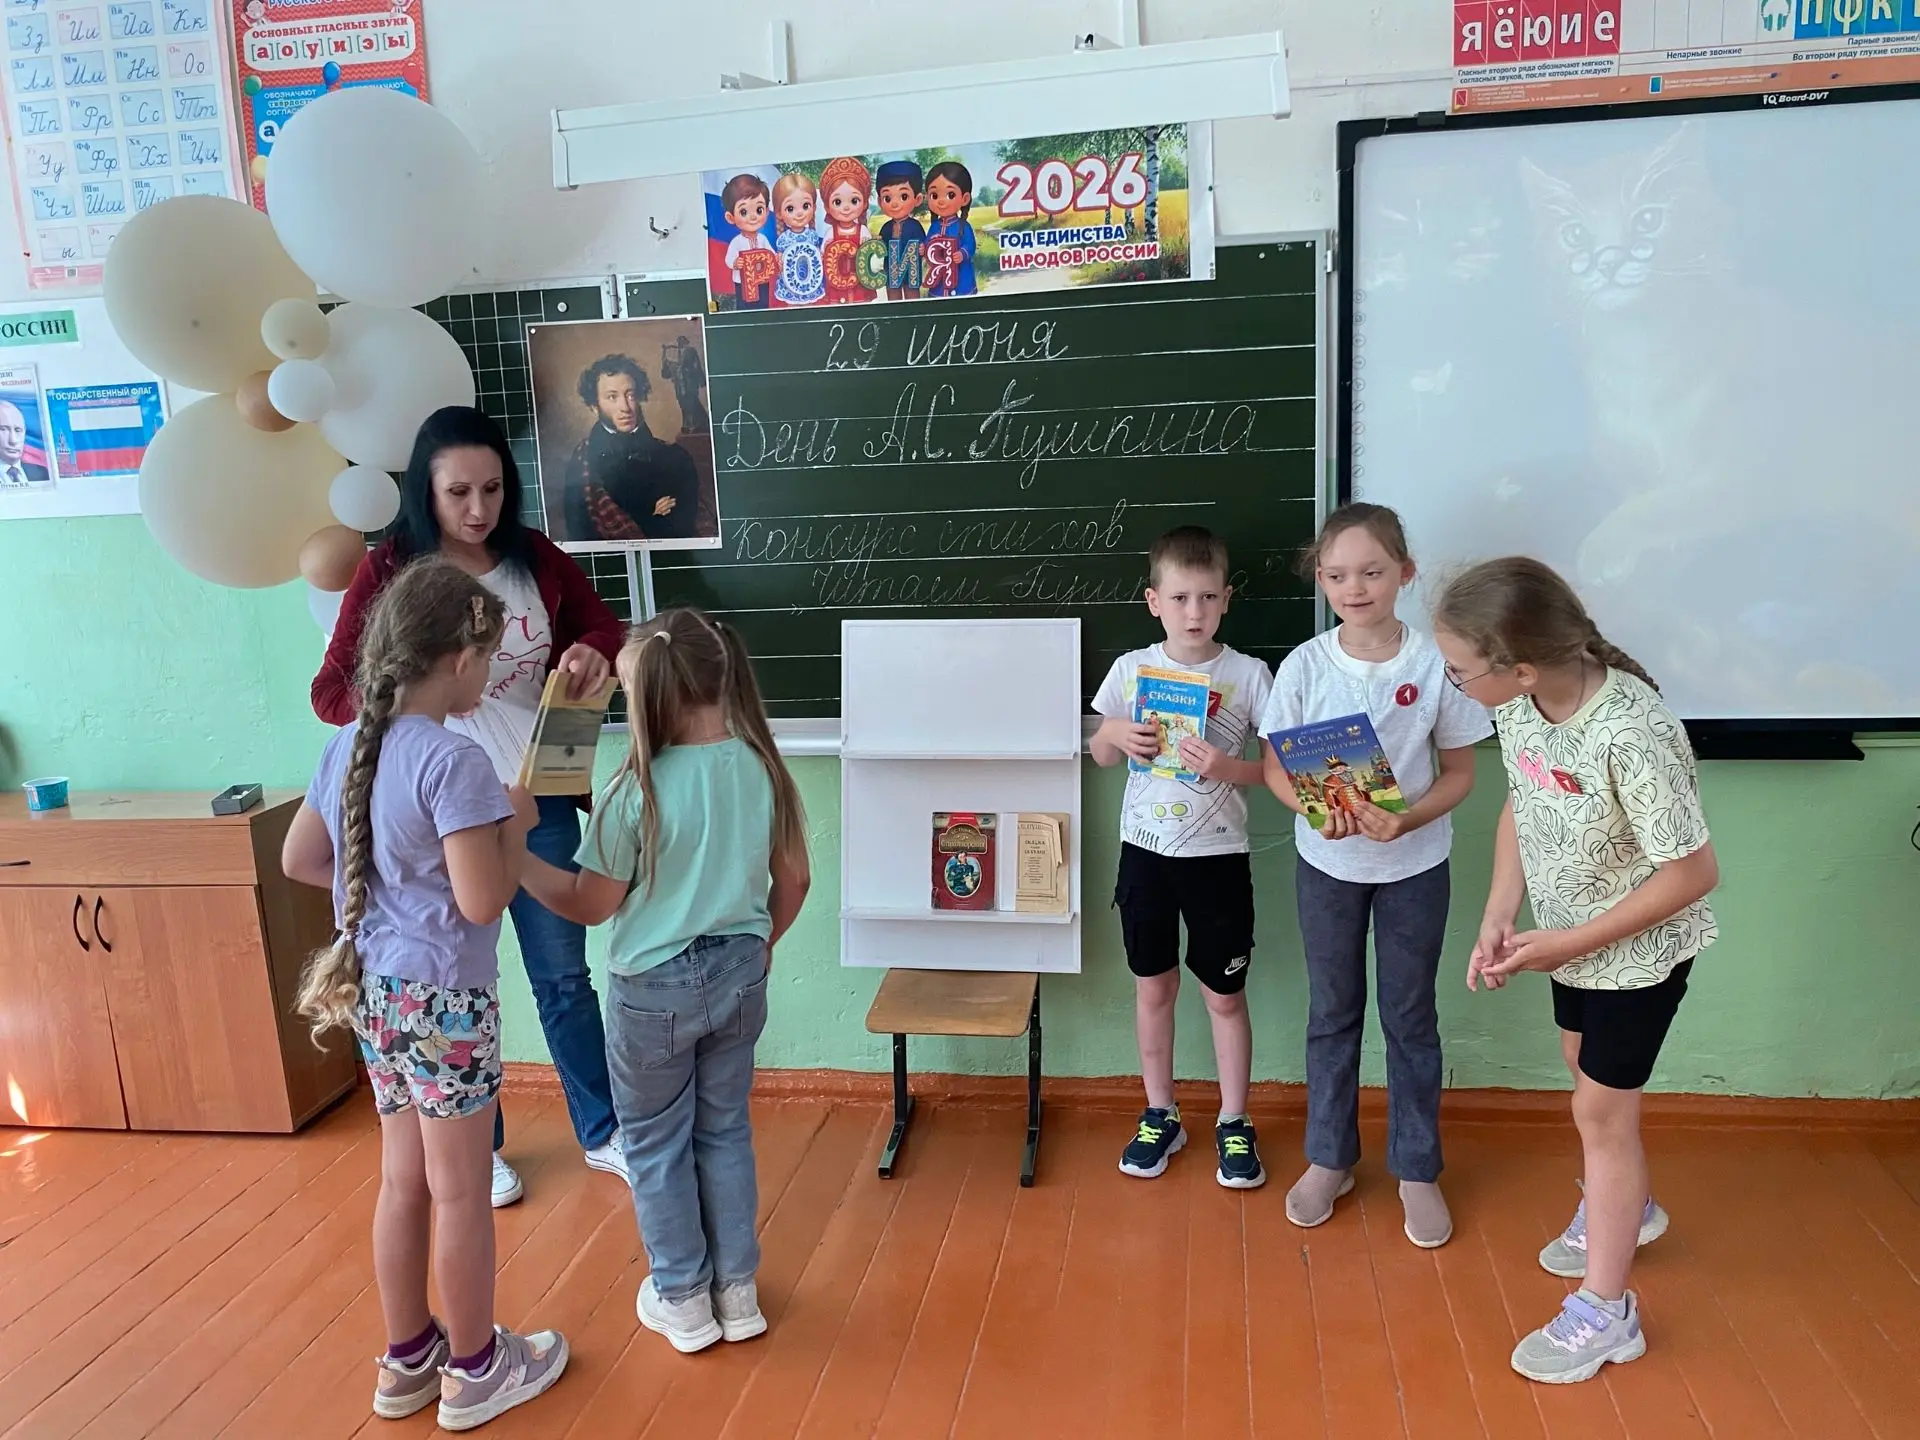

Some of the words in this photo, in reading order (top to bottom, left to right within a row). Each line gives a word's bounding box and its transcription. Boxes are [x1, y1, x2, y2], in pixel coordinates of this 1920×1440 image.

[252, 25, 313, 39] ОСНОВНЫЕ
[316, 20, 369, 33] ГЛАСНЫЕ
[371, 17, 408, 28] ЗВУКИ
[1848, 37, 1880, 46] Парные
[1666, 50, 1707, 59] Непарные
[1709, 47, 1742, 56] звонкие
[1792, 53, 1804, 61] Во
[1805, 52, 1835, 61] втором
[1837, 50, 1858, 59] ряду
[1859, 48, 1888, 57] глухие
[1460, 75, 1496, 84] согласных
[1548, 70, 1578, 78] которых
[1580, 67, 1611, 75] следуют
[1489, 67, 1517, 75] второго
[1518, 65, 1536, 73] ряда
[1537, 62, 1580, 70] обозначают
[264, 89, 317, 99] ОБОЗНАЧАЮТ
[1778, 91, 1829, 103] Board-DVT
[263, 125, 276, 137] а
[996, 152, 1149, 217] 2026
[1000, 232, 1034, 248] ГОД
[1037, 225, 1125, 246] ЕДИНСТВА
[1001, 249, 1083, 269] НАРОДОВ
[1086, 243, 1158, 263] РОССИИ
[739, 237, 959, 303] РОССИЯ
[0, 319, 68, 338] ОССИИ
[826, 321, 880, 370] 29
[906, 320, 1069, 366] июня
[51, 387, 130, 401] ГОСУДАРСТВЕННЫЙ
[131, 386, 153, 395] ФЛАГ
[722, 395, 839, 468] День
[969, 379, 1262, 489] Пушкина
[731, 517, 916, 580] Конкурс
[939, 498, 1128, 553] стихов
[1148, 690, 1196, 706] СКАЗКИ
[1230, 955, 1247, 968] NIKE
